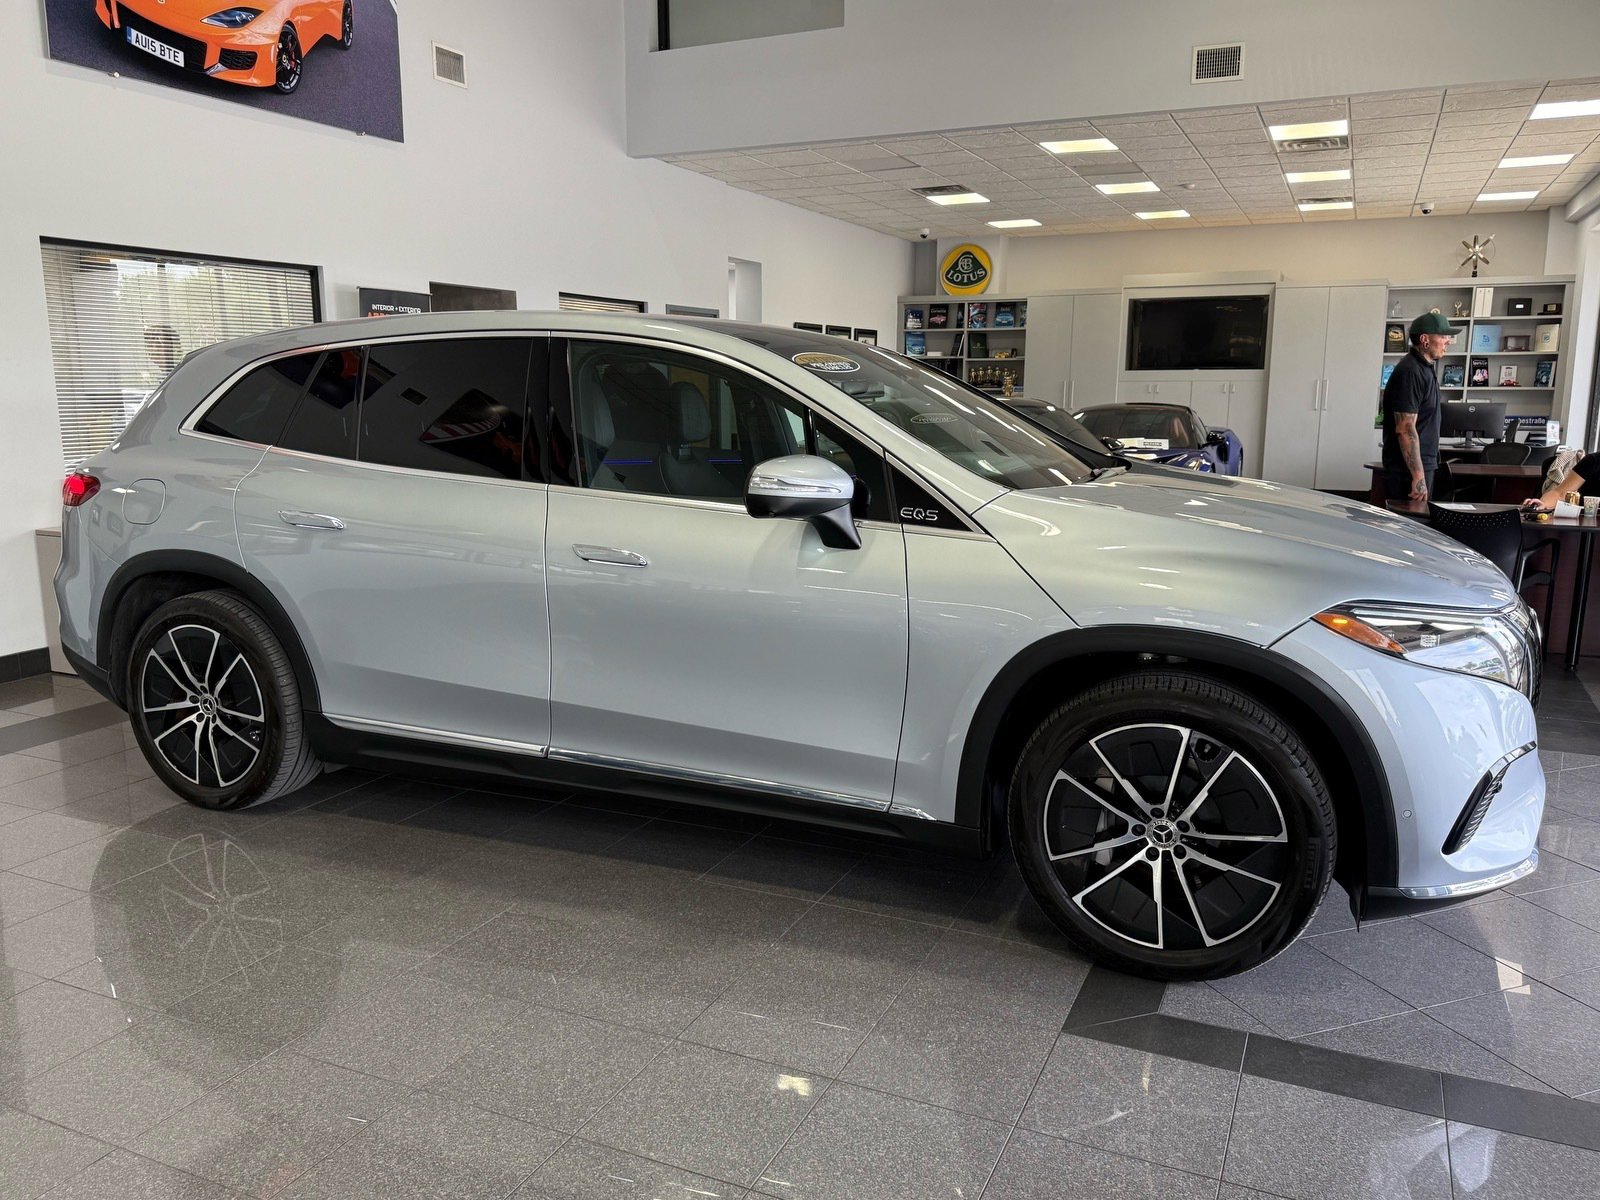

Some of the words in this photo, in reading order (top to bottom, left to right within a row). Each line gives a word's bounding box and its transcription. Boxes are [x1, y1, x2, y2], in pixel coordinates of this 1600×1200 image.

[135, 33, 157, 53] AU15
[159, 43, 180, 63] BTE
[947, 268, 986, 283] LOTUS
[371, 303, 395, 312] INTERIOR
[900, 506, 939, 521] EQS
